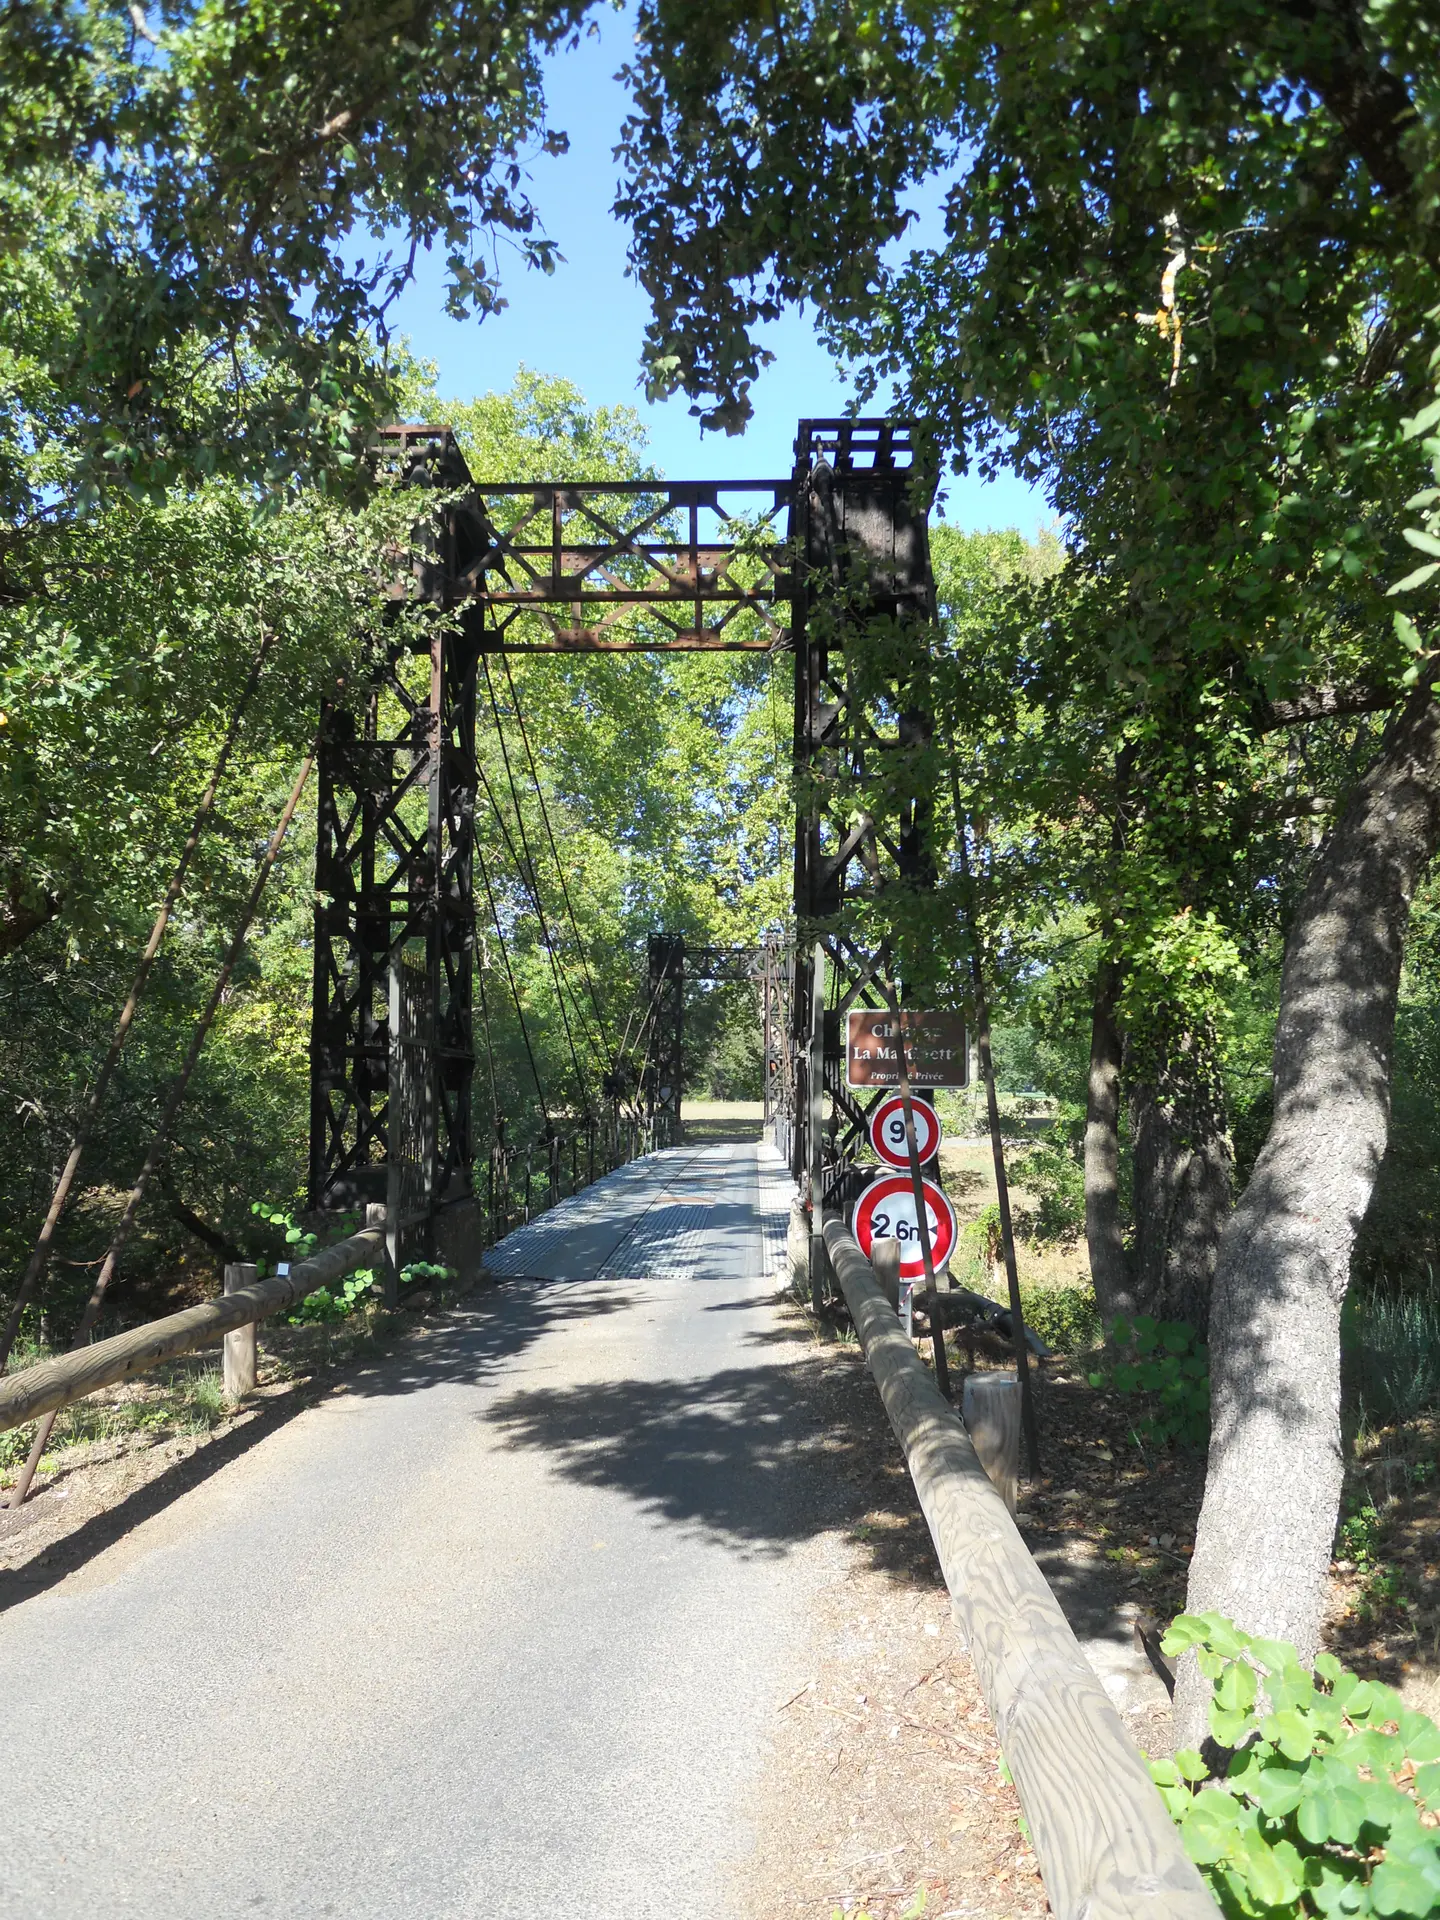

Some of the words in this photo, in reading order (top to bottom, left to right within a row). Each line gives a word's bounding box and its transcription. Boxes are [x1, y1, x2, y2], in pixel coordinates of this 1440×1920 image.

[853, 1046, 871, 1060] La
[870, 1071, 914, 1081] Proprié
[916, 1070, 945, 1081] Privée
